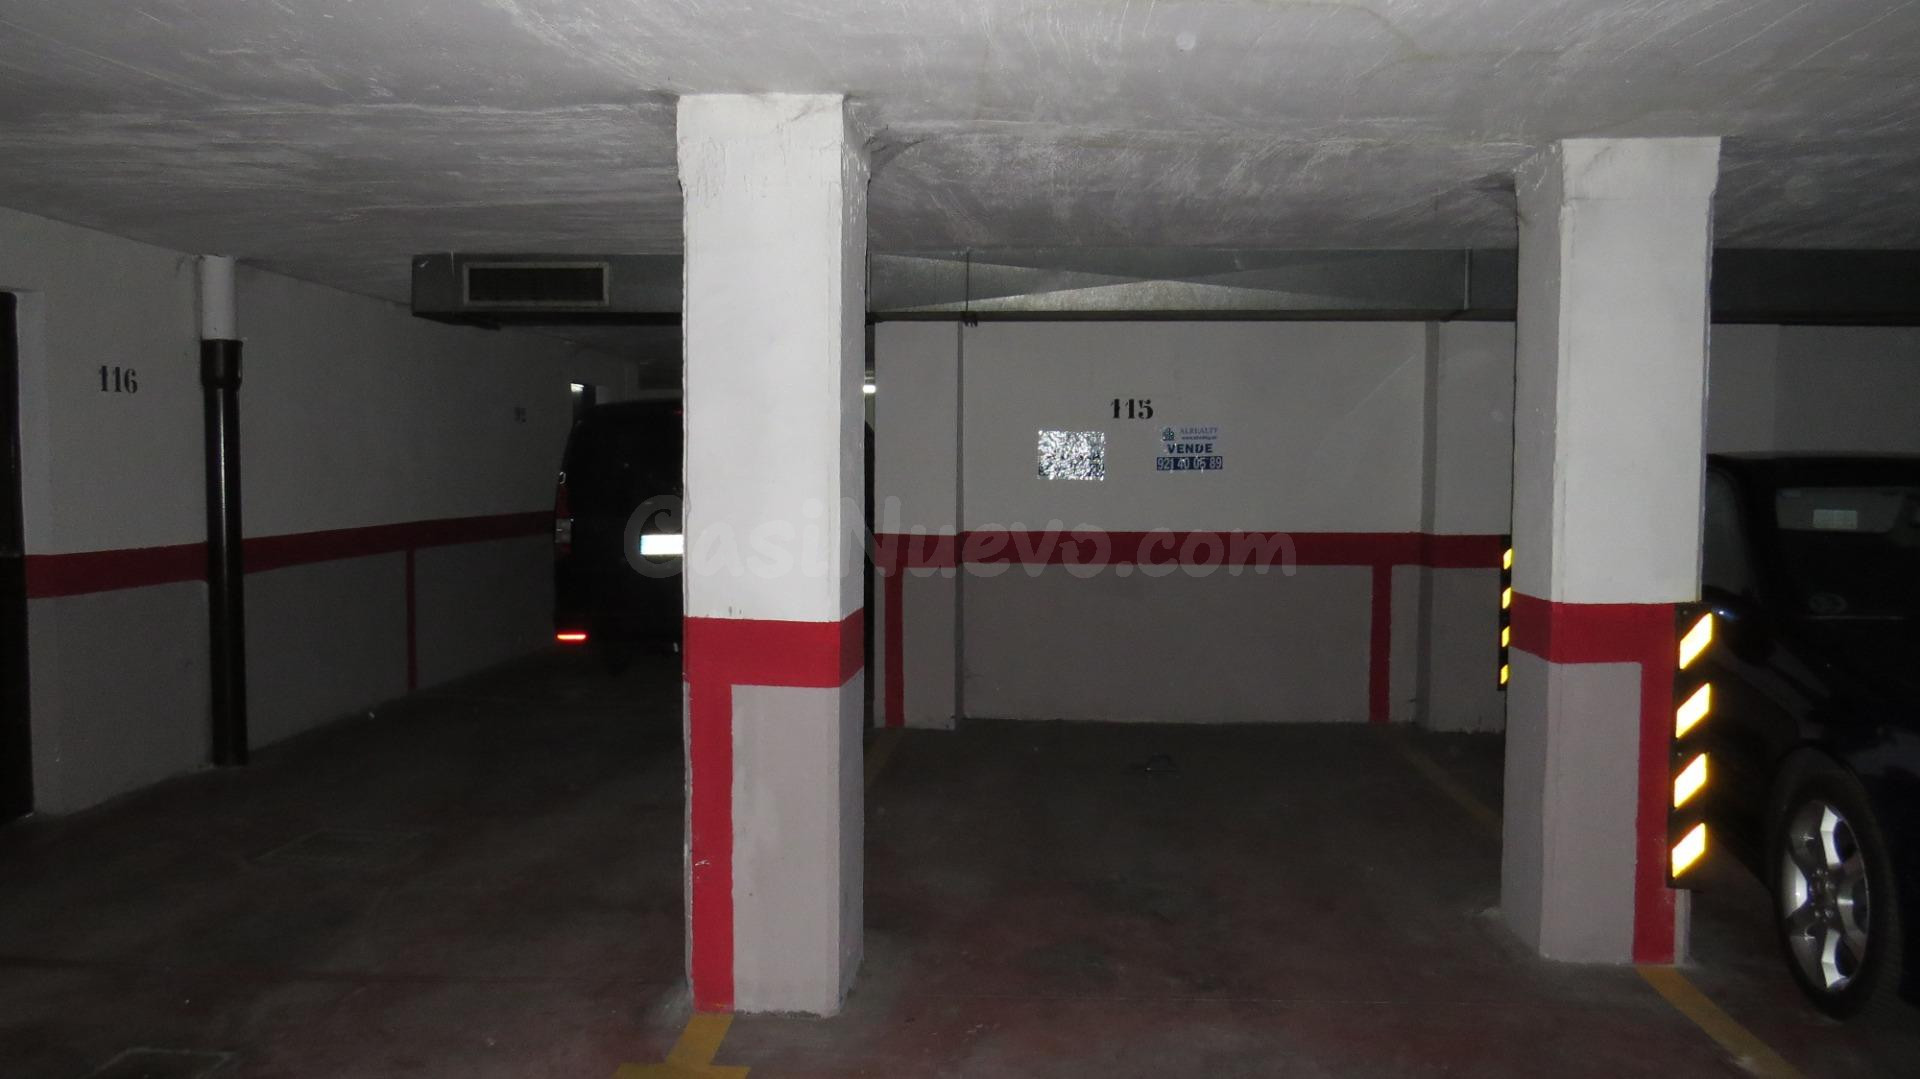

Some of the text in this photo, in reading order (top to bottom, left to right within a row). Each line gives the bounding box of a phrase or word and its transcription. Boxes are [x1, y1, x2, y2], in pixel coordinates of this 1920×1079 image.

[98, 365, 138, 394] 116
[1110, 398, 1154, 420] 115
[1167, 443, 1213, 454] VENDE
[1157, 457, 1174, 470] 921
[1177, 457, 1190, 469] 40
[1209, 456, 1222, 469] 89
